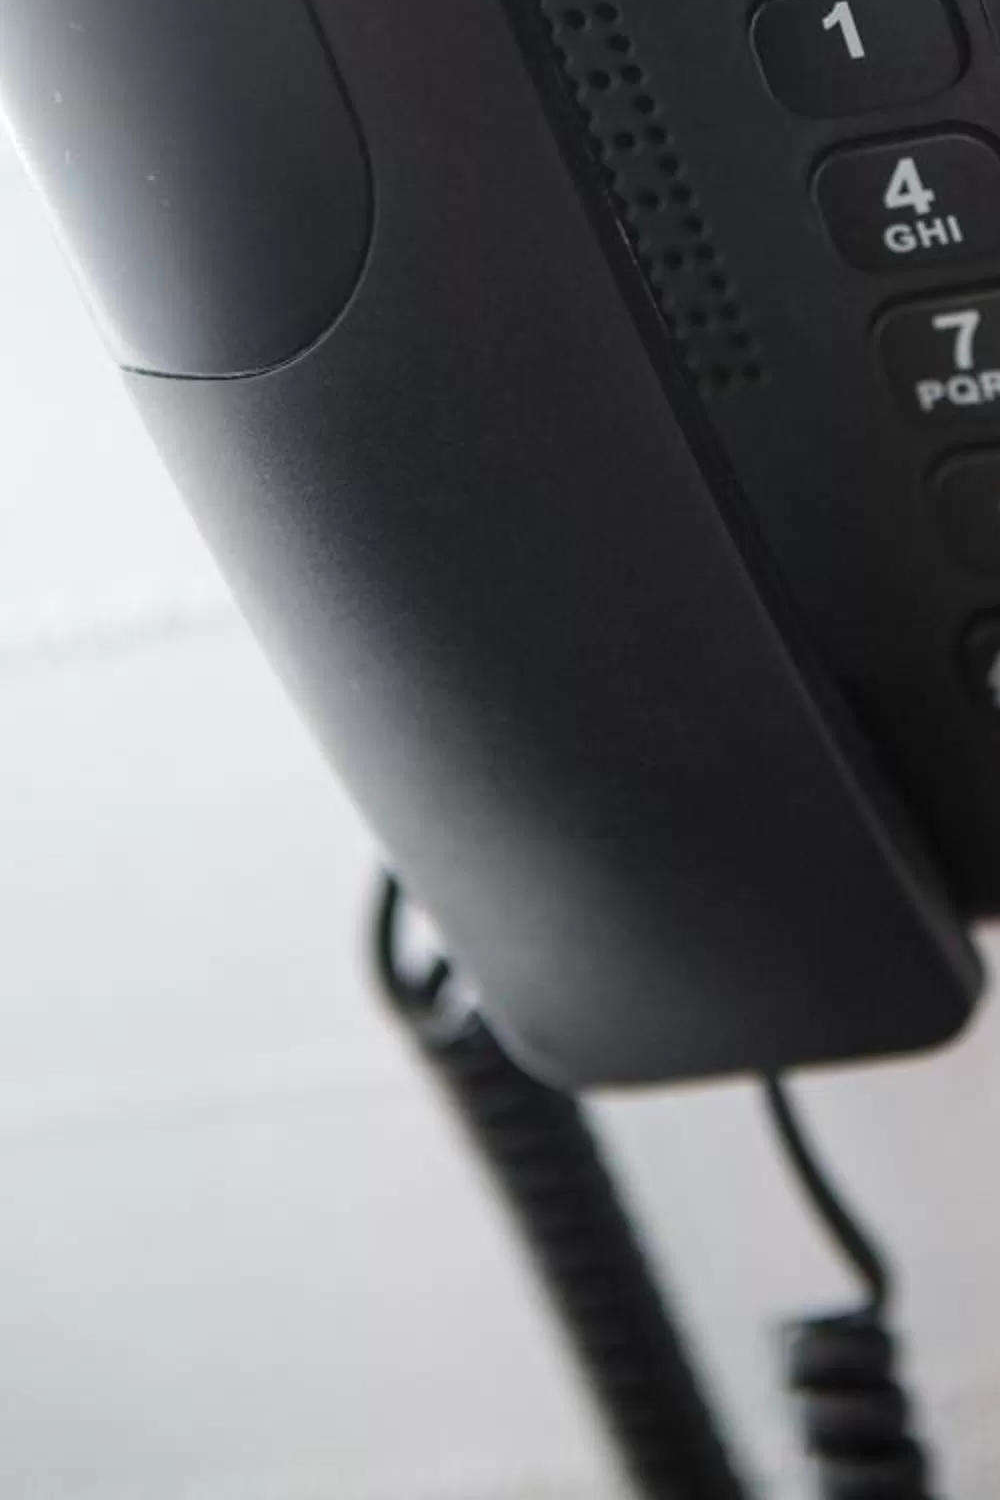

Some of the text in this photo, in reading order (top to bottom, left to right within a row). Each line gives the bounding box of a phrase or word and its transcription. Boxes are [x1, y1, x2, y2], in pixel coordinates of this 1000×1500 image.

[821, 0, 865, 59] 1
[884, 157, 935, 215] 4
[884, 215, 963, 253] GHI
[932, 309, 980, 370] 7
